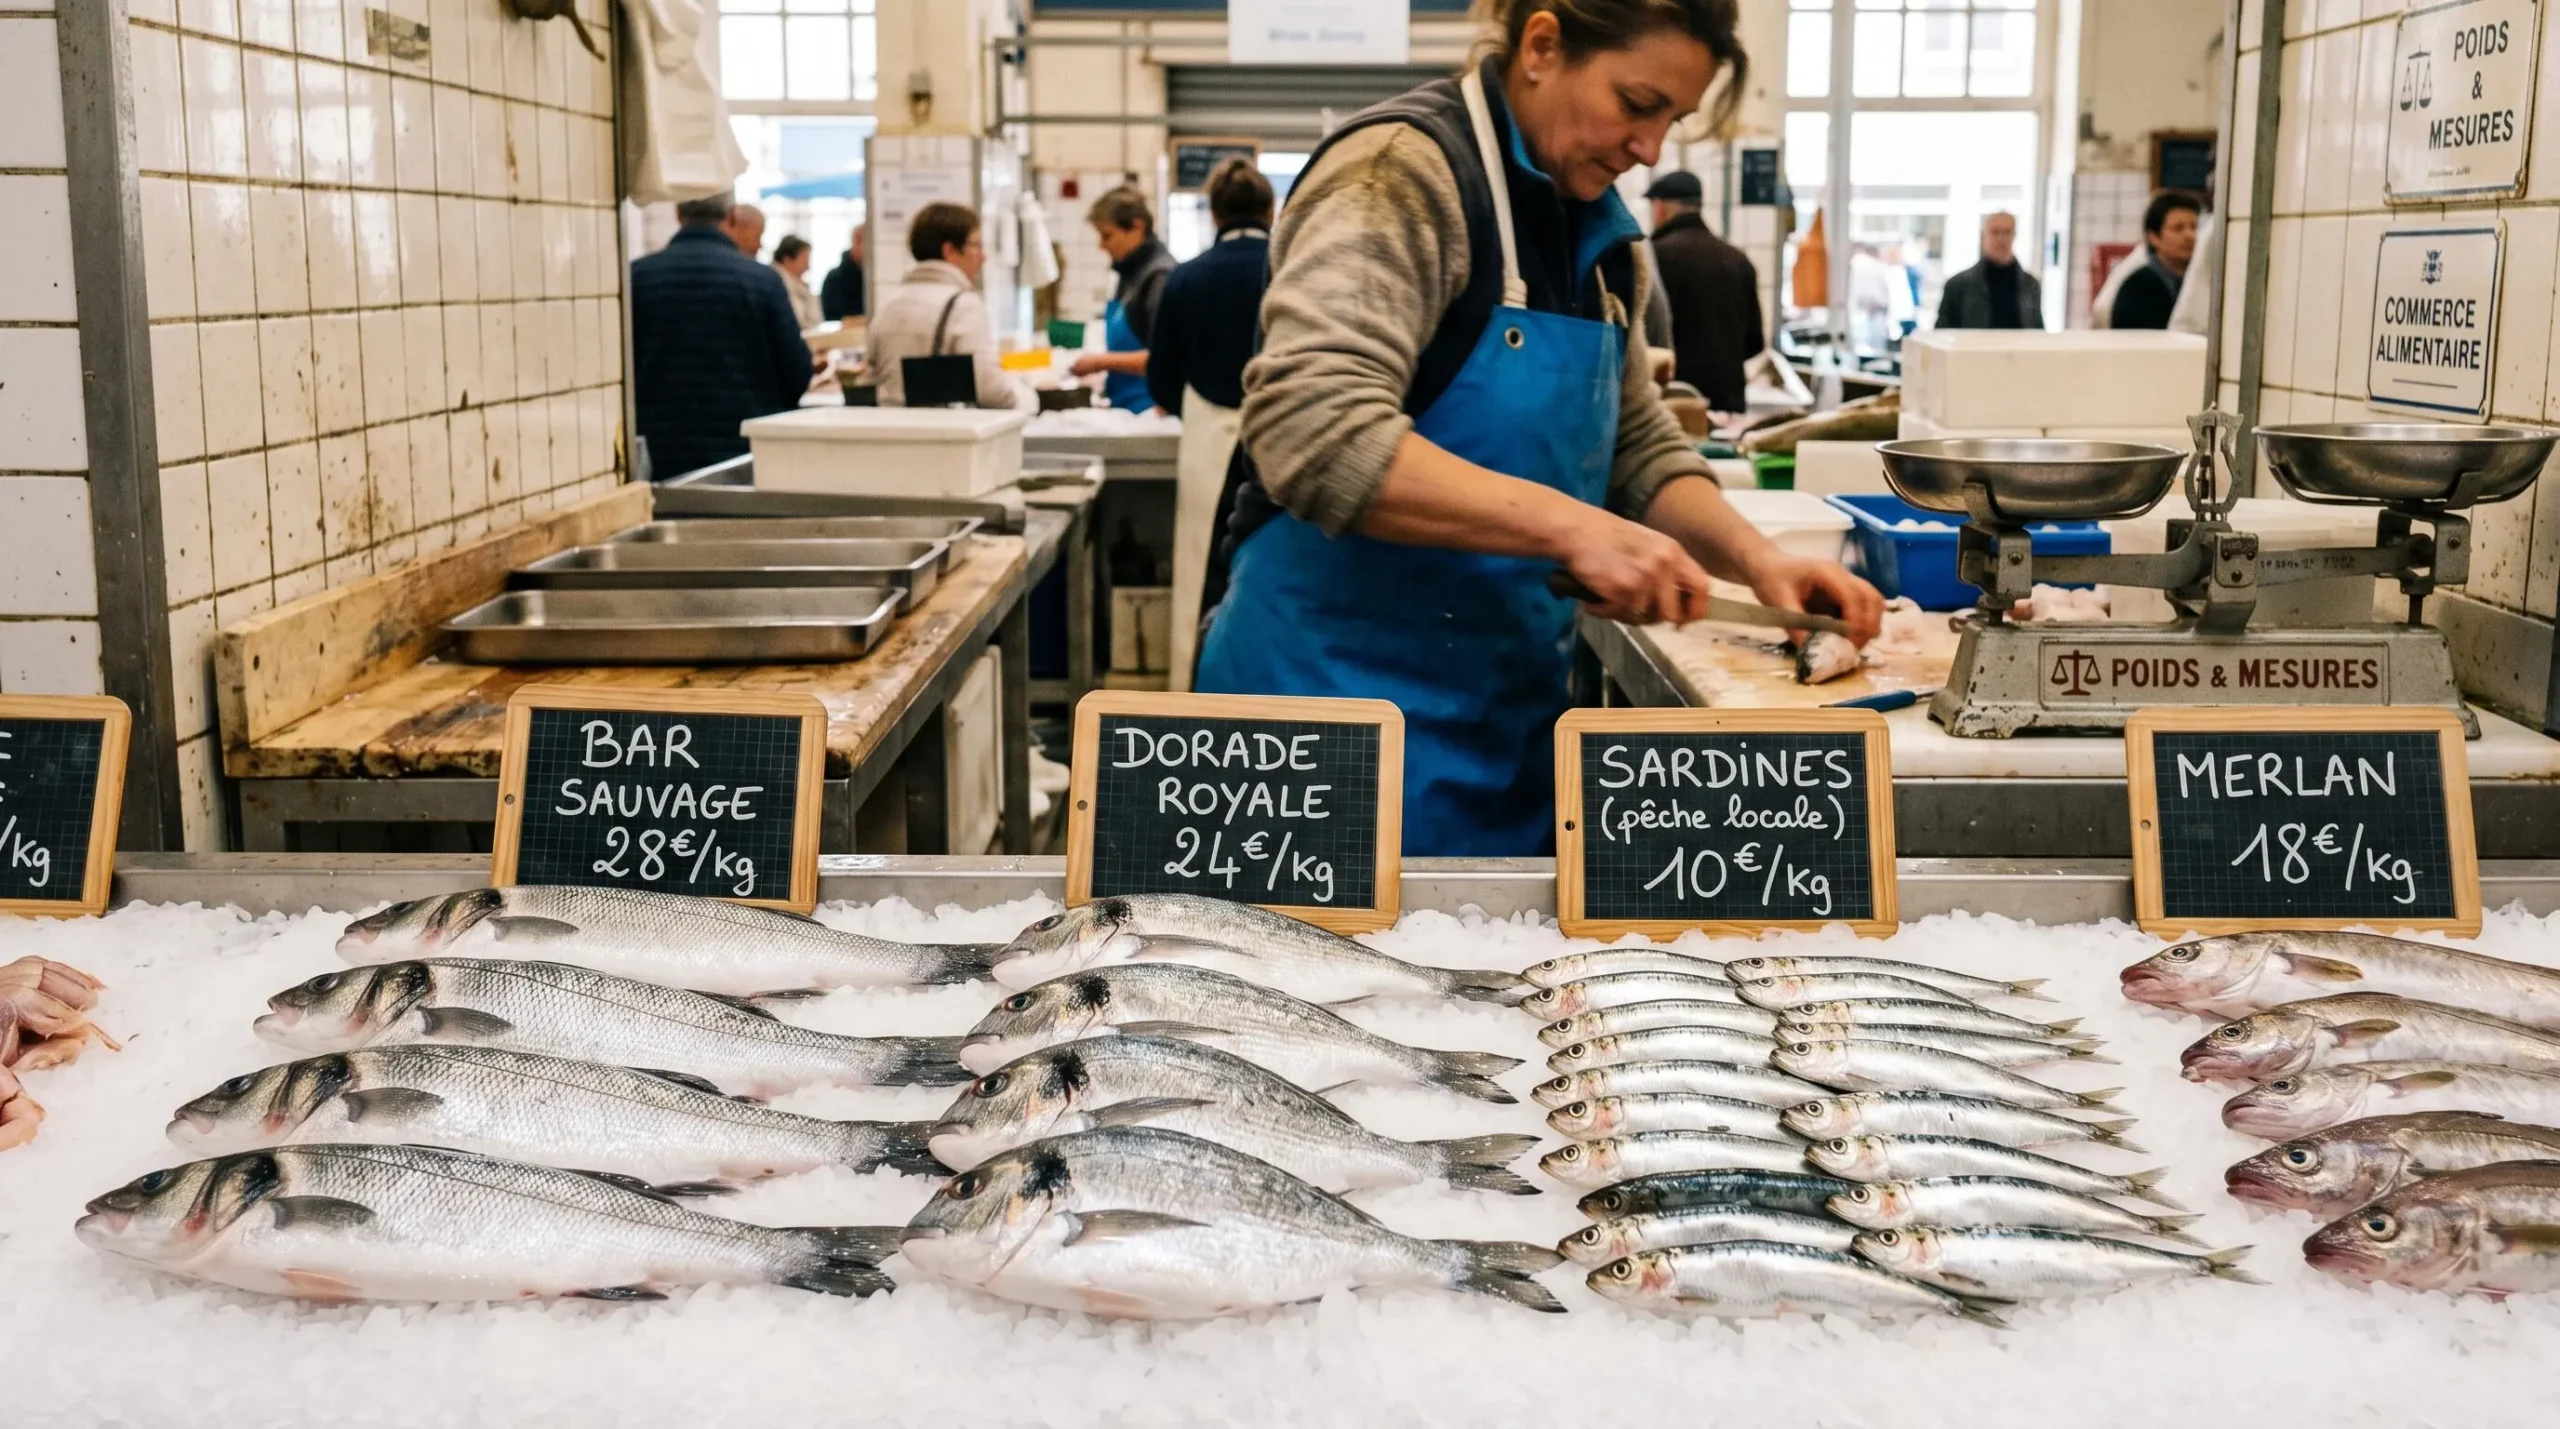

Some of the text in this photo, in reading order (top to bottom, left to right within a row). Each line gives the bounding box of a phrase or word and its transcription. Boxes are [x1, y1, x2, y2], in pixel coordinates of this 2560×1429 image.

[2453, 20, 2510, 62] POIDS
[2471, 70, 2483, 100] &
[2428, 108, 2514, 151] MESURES
[2384, 296, 2476, 328] COMMERCE
[2375, 334, 2481, 370] ALIMENTAIRE
[2111, 657, 2379, 689] POIDS & MESURES
[580, 719, 700, 769] BAR
[1112, 727, 1320, 771] DORADE
[2177, 751, 2396, 799] MERLAN
[555, 778, 764, 820] SAUVAGE
[1158, 776, 1332, 825] ROYALE
[1601, 793, 1846, 845] (pêche locale)
